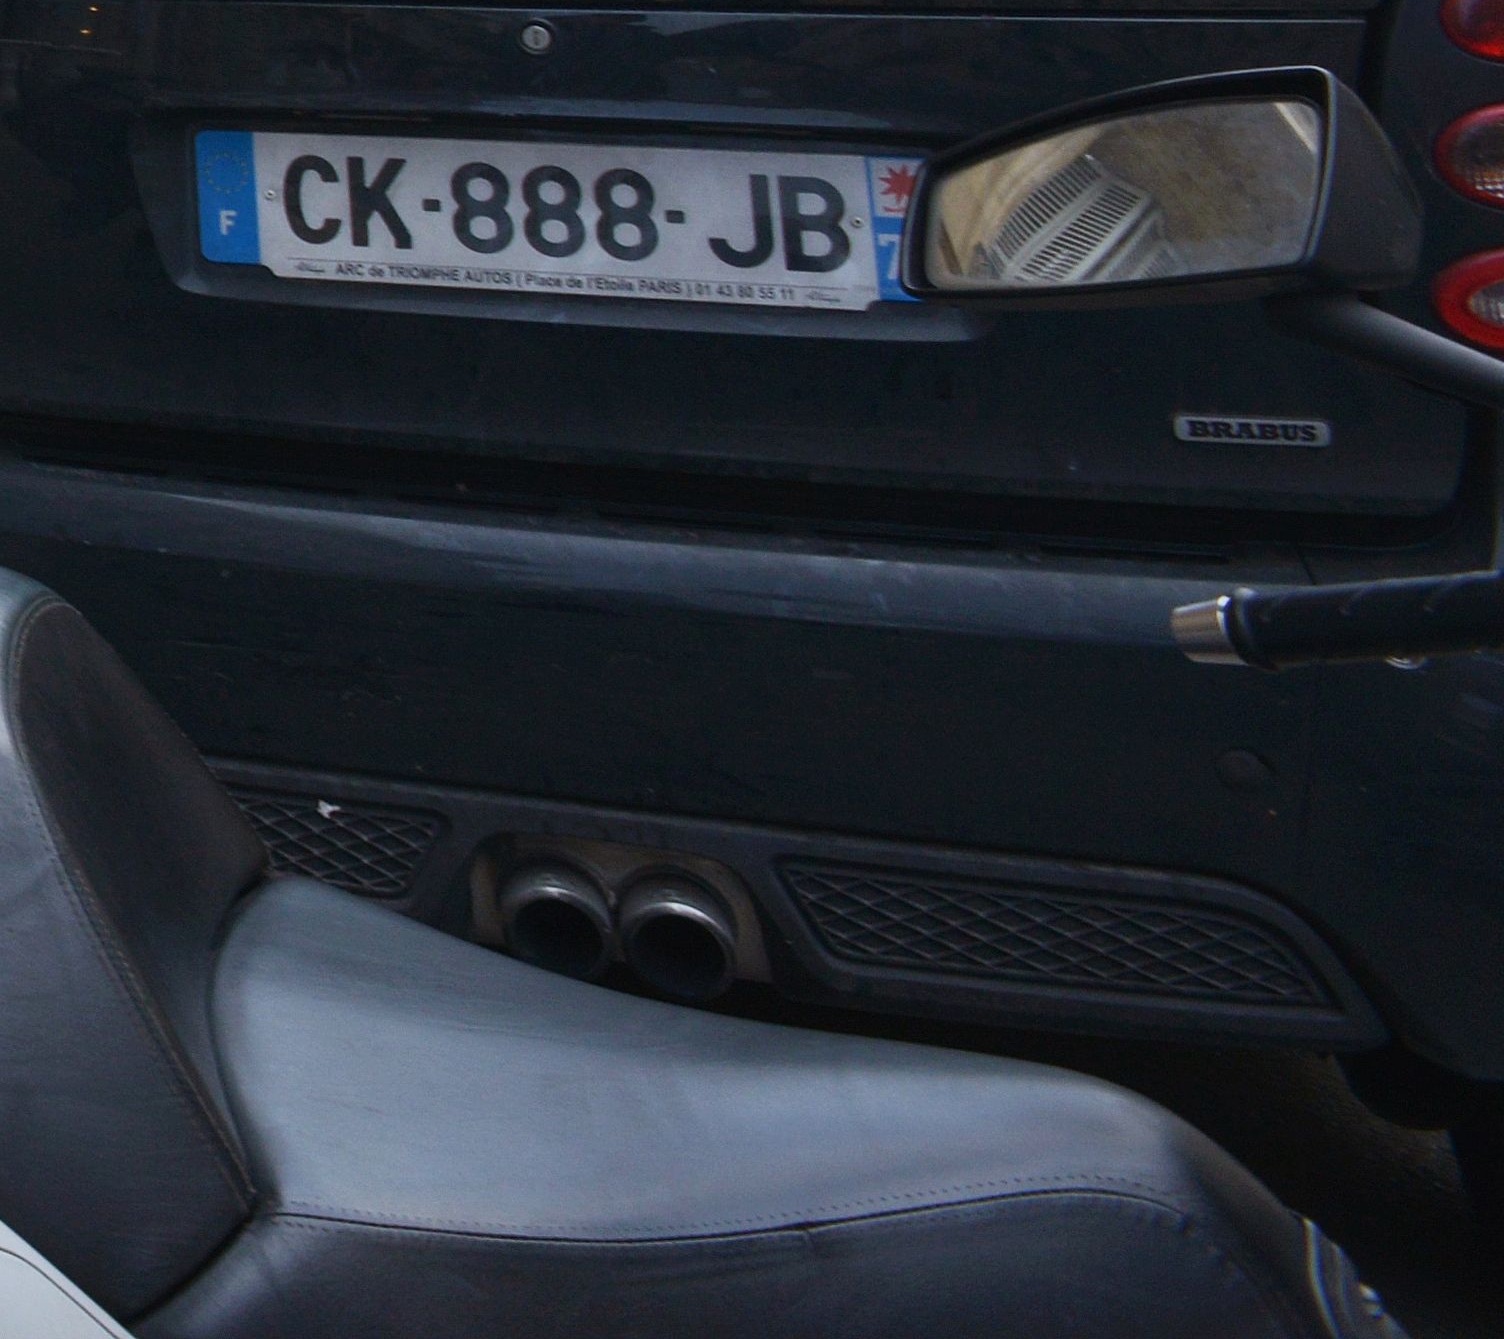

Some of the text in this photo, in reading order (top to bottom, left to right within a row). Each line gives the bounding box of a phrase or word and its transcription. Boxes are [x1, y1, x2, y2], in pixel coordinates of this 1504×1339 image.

[218, 209, 236, 236] F
[282, 154, 853, 274] CK-888-JB
[335, 263, 365, 276] ARC
[388, 265, 460, 282] TRIOMPHE
[464, 270, 512, 285] AUTOS
[638, 279, 681, 294] PARIS
[1189, 420, 1317, 442] BRABUS
